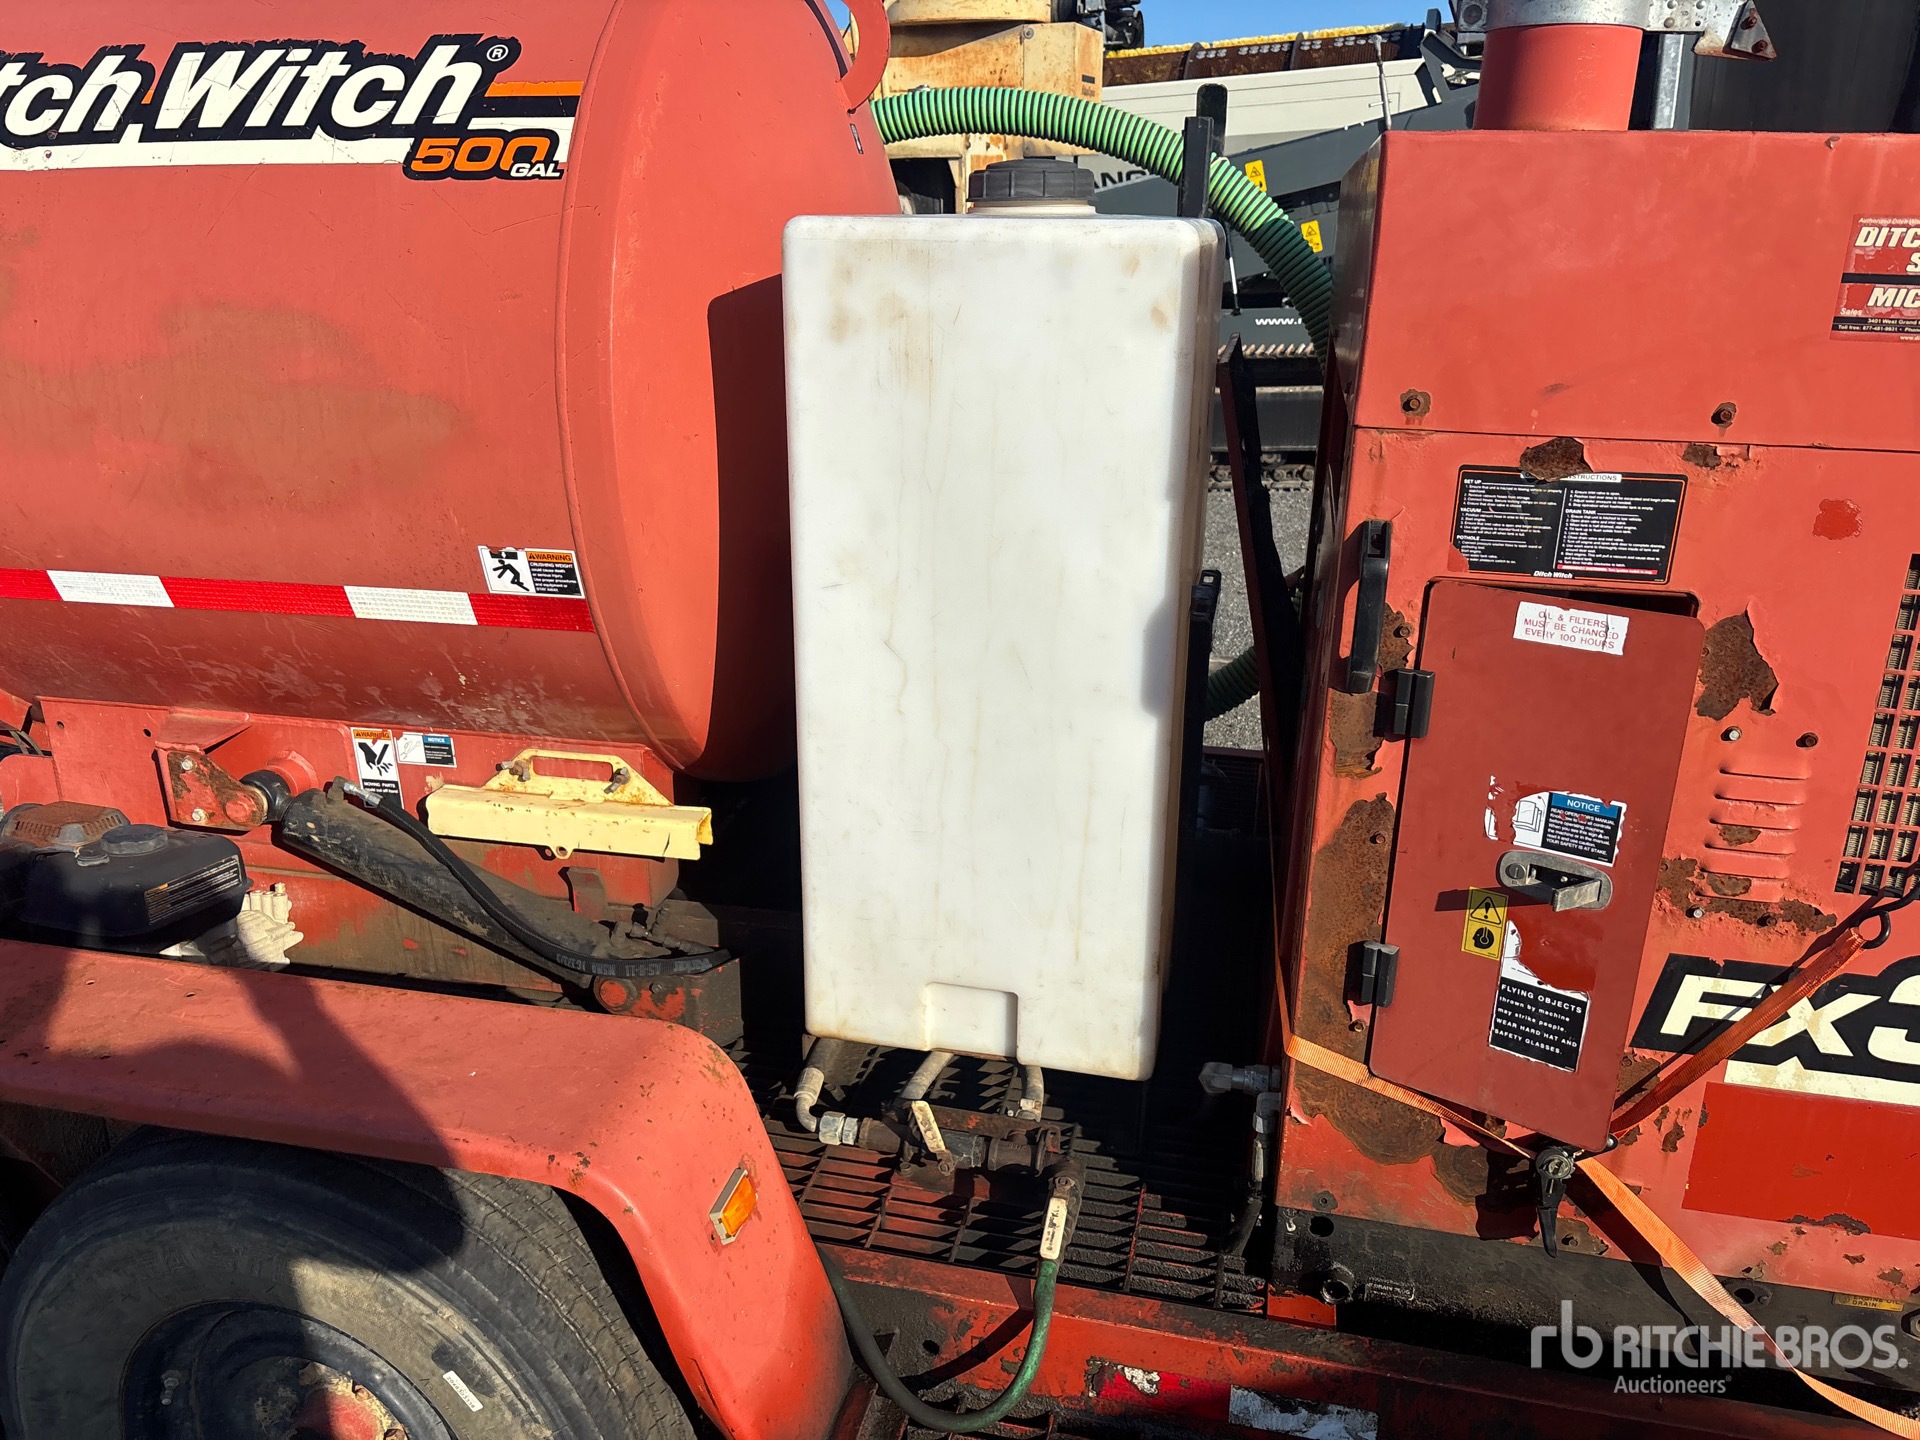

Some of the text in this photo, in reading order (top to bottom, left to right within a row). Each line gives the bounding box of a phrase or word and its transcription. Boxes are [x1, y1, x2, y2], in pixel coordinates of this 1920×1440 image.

[155, 46, 482, 130] Witch
[411, 136, 552, 172] 500
[510, 162, 563, 178] GAL
[1840, 307, 1862, 316] Sales
[534, 552, 571, 562] WARNING
[1537, 610, 1553, 619] OL
[1557, 613, 1564, 621] &
[1553, 622, 1567, 631] BE
[1559, 633, 1576, 642] 100
[1566, 798, 1600, 812] NOTICE
[1498, 995, 1570, 1022] thrown by machine
[1500, 983, 1582, 1014] FLYING OBJECTS
[1497, 1007, 1567, 1033] may strike people.
[1494, 1028, 1563, 1054] SAFETY GLASSES.
[1495, 1017, 1577, 1048] WEAR HARD HAT AND
